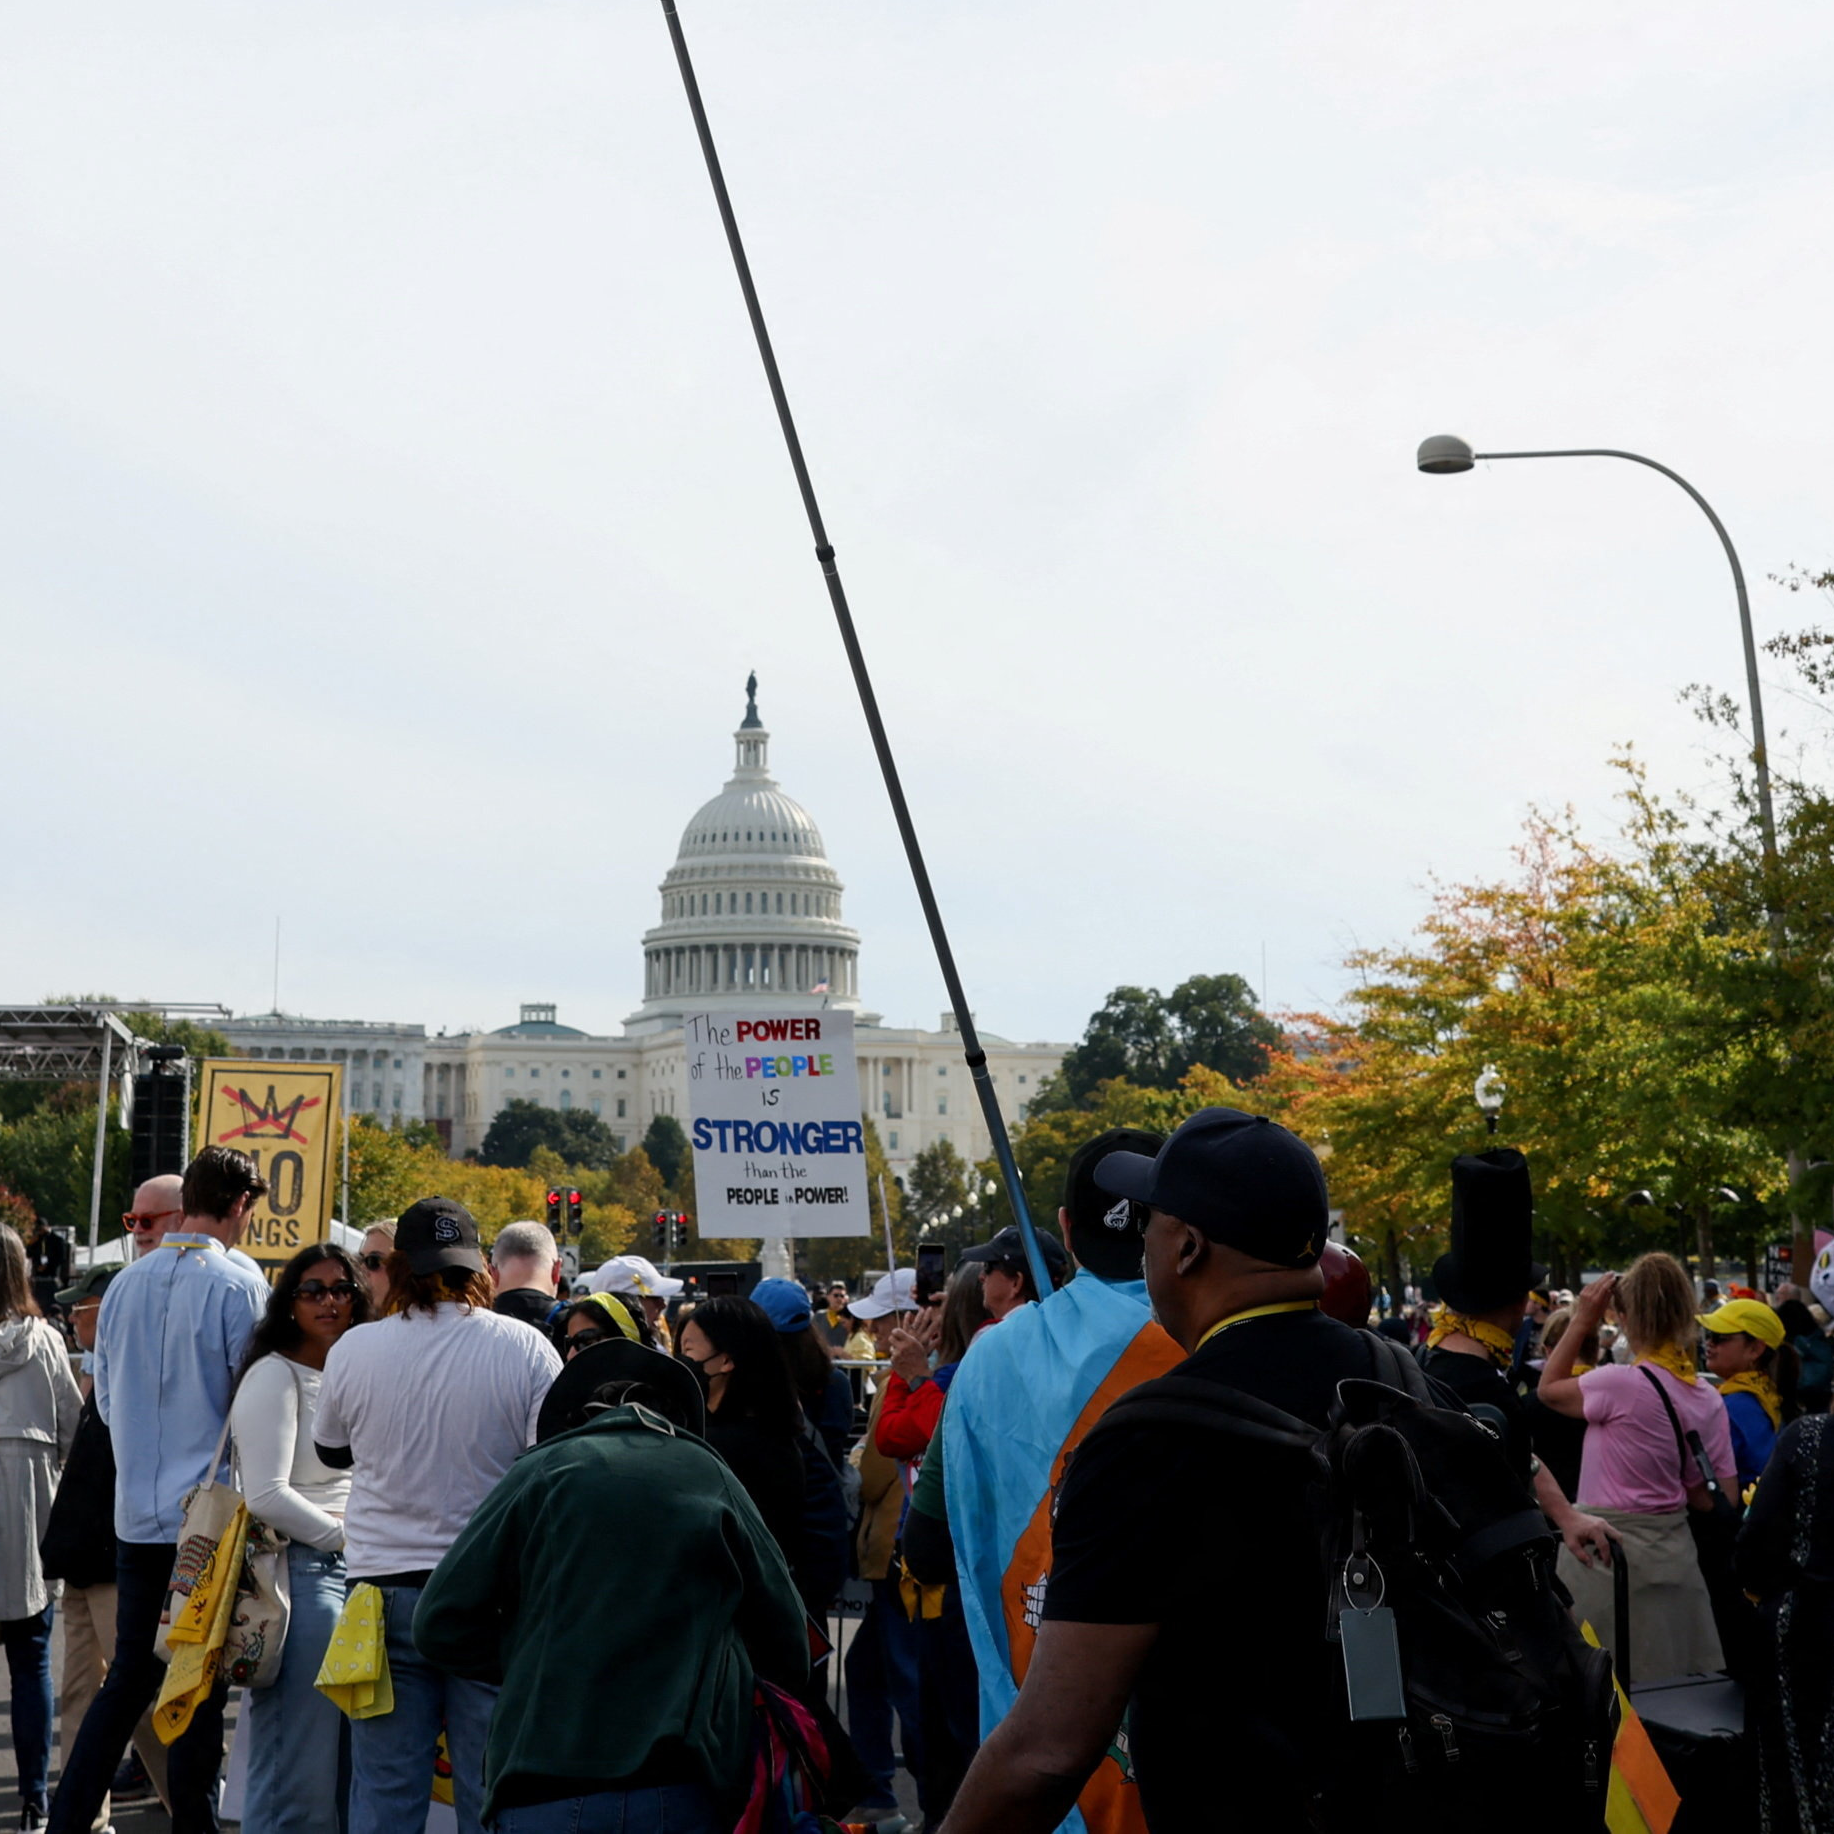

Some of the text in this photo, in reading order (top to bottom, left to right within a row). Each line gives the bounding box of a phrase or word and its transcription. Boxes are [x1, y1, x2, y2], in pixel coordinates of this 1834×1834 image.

[688, 1014, 821, 1046] The POWER
[691, 1052, 835, 1080] of the PEOPLE
[761, 1086, 780, 1106] is
[692, 1117, 865, 1155] STRONGER
[743, 1160, 807, 1180] than the
[727, 1186, 849, 1205] PEOPLE in POWER!
